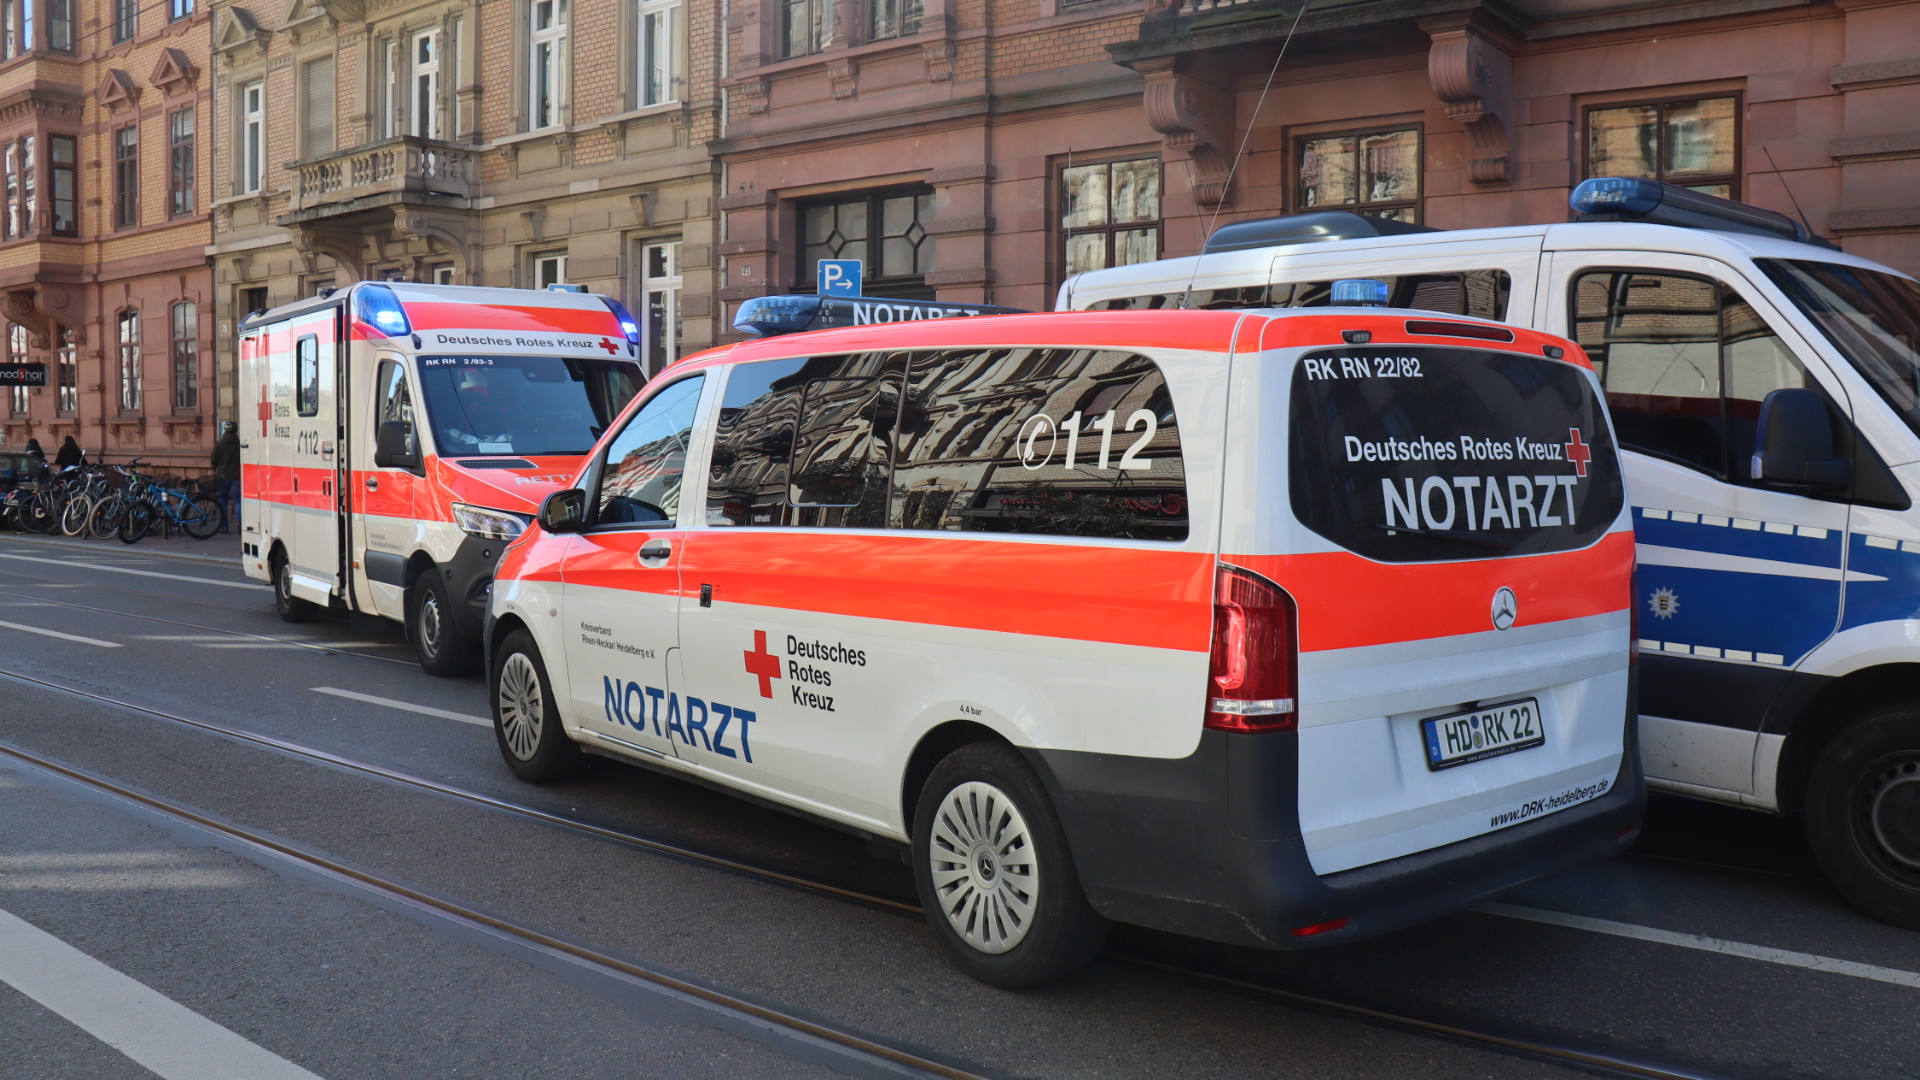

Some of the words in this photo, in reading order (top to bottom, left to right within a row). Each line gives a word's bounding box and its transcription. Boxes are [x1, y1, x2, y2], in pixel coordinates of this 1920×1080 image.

[824, 264, 842, 290] P
[853, 303, 979, 326] NOTAR
[437, 334, 512, 346] Deutsches
[516, 338, 554, 347] Rotes
[557, 339, 593, 348] Kreuz
[1304, 358, 1338, 380] RK
[1340, 358, 1371, 379] RN
[1373, 357, 1423, 378] 22/82
[274, 402, 290, 418] Rotes
[274, 423, 290, 438] Kreuz
[304, 430, 318, 455] 112
[1060, 408, 1157, 470] 112
[1344, 435, 1457, 462] Deutsches
[1460, 435, 1513, 461] Rotes
[1515, 436, 1563, 461] Kreuz
[514, 474, 573, 485] RETT
[1381, 475, 1578, 536] NOTARZT
[580, 621, 612, 636] Kreisverband
[616, 641, 645, 659] Heidelberg
[645, 649, 656, 659] e.V.
[787, 634, 866, 666] Deutsches
[788, 660, 831, 686] Rotes
[791, 685, 836, 712] Kreuz
[960, 704, 970, 714] 4,4
[970, 706, 982, 716] bar
[603, 675, 757, 763] NOTARZT
[1444, 720, 1473, 754] HD
[1481, 711, 1509, 745] RK
[1510, 706, 1534, 739] 22
[1432, 746, 1438, 755] D
[1490, 778, 1609, 827] www.DRK-heidelberg.de
